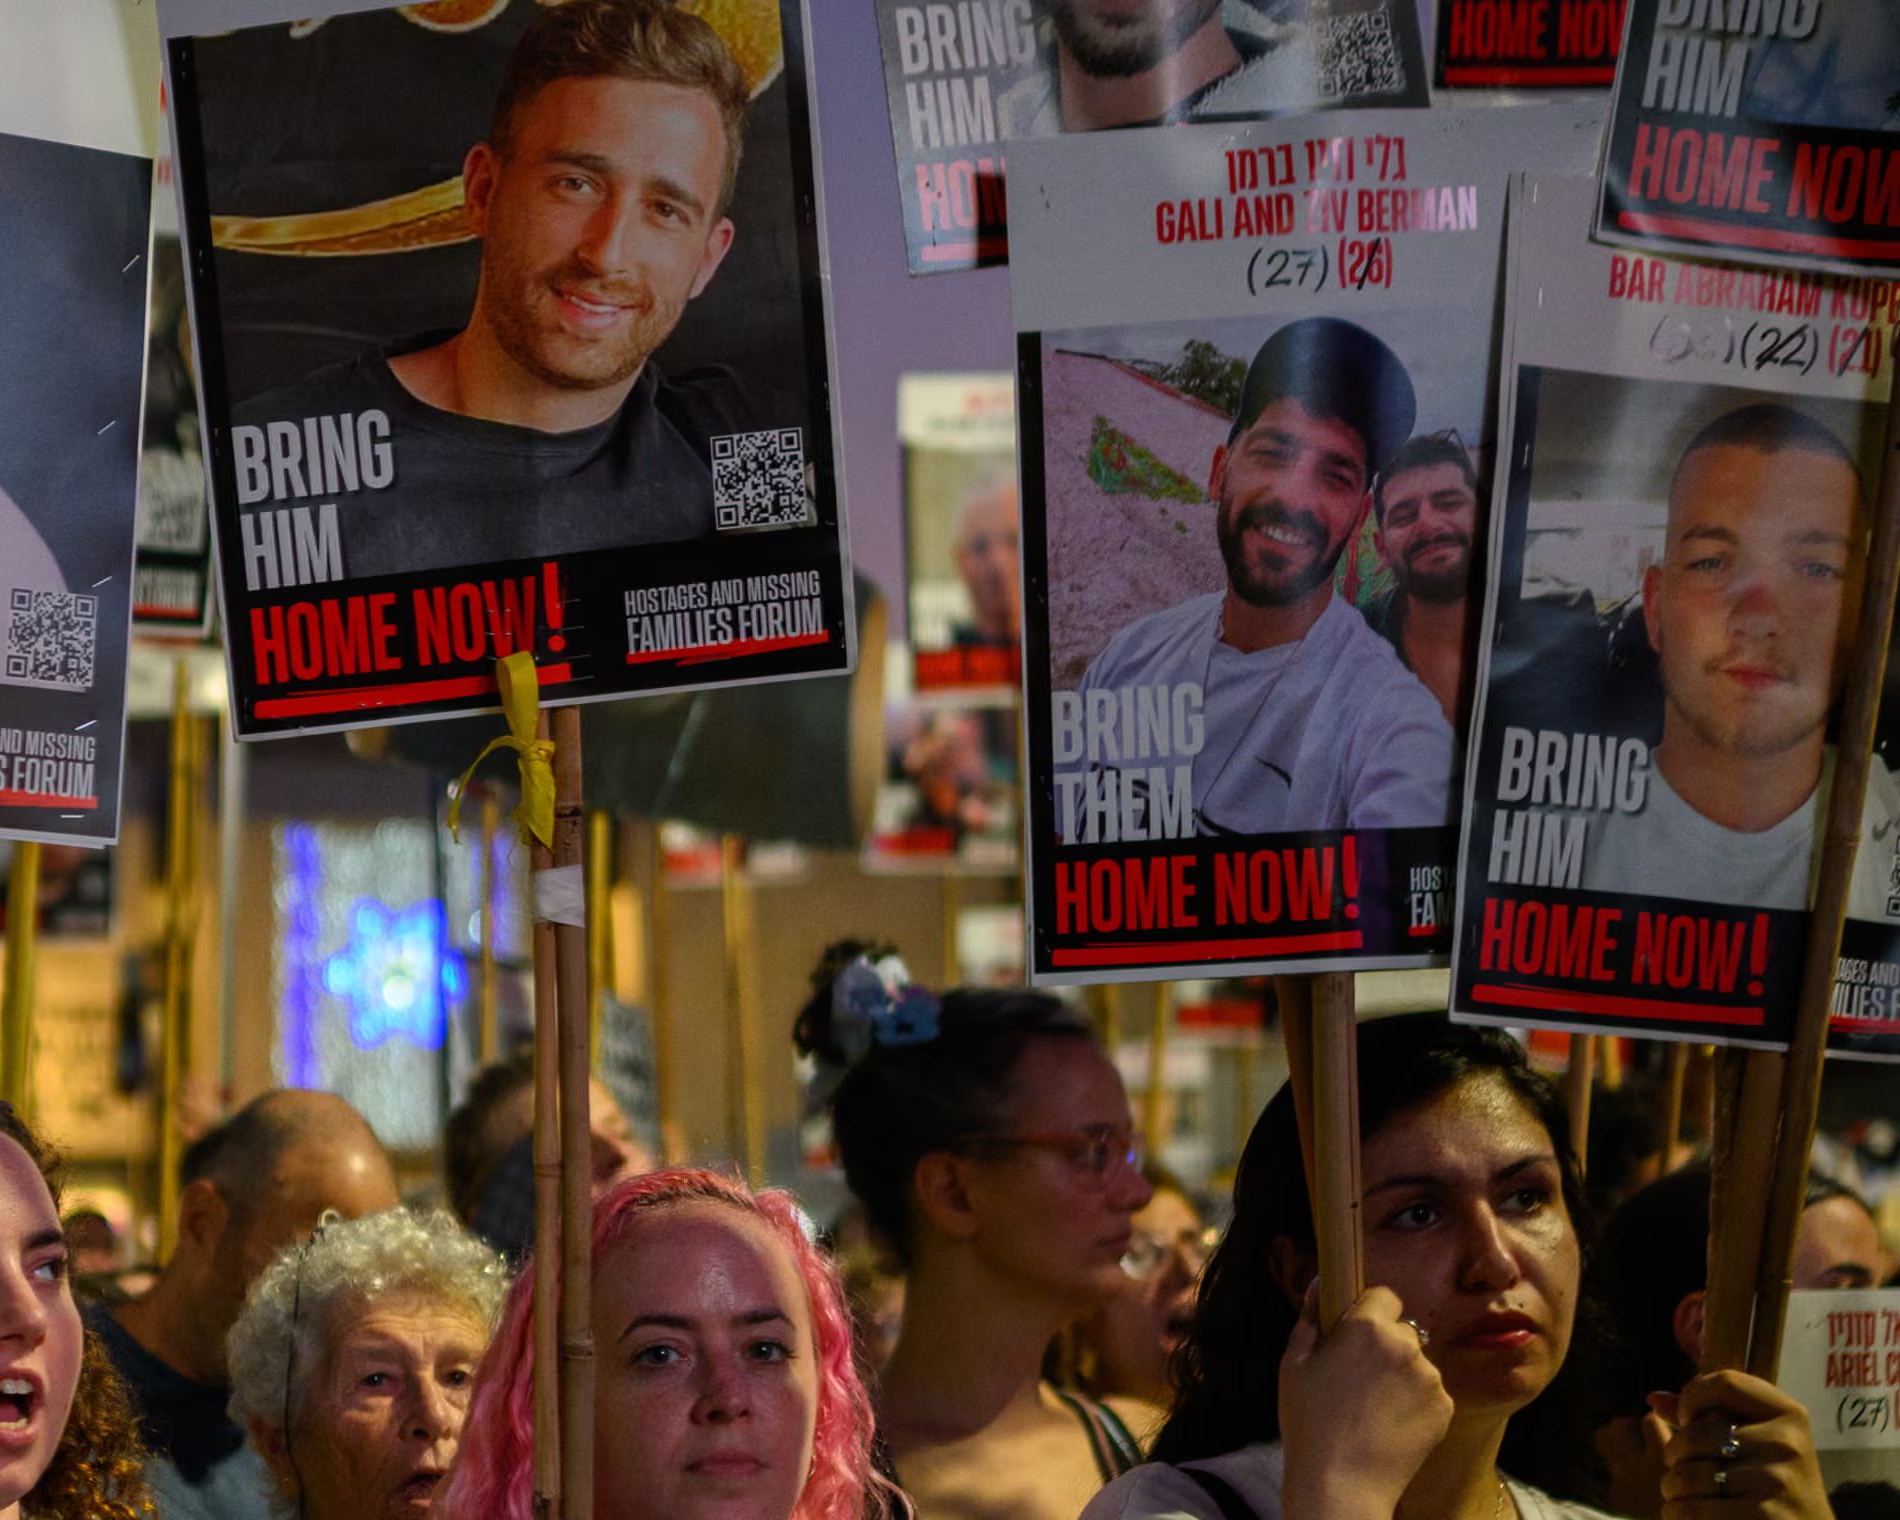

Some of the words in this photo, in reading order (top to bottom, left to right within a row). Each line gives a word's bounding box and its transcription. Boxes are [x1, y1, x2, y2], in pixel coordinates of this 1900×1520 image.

[896, 0, 1037, 75] BRING
[1448, 0, 1551, 60] HOME
[1641, 32, 1752, 118] HIM
[906, 76, 996, 149] HIM
[1225, 143, 1296, 194] ברמן
[1365, 133, 1406, 181] גלי
[1628, 123, 1780, 214] HOME
[1156, 196, 1223, 246] GALI
[1233, 193, 1296, 239] AND
[1304, 188, 1349, 235] ZIV
[1357, 185, 1477, 234] BERMAN
[1247, 244, 1329, 296] (27)
[1609, 254, 1667, 304] BAR
[231, 409, 395, 504] BRING
[240, 504, 344, 592] HIM
[249, 592, 403, 686] HOME
[412, 561, 566, 658] NOW!
[624, 581, 708, 616] HOSTAGES
[711, 578, 744, 607] AND
[746, 570, 821, 602] MISSING
[627, 607, 734, 655] FAMILIES
[738, 597, 823, 642] FORUM
[26, 731, 96, 762] MISSING
[1051, 681, 1205, 764] BRING
[12, 758, 95, 798] FORUM
[1053, 765, 1197, 846] THEM
[1497, 726, 1650, 813] BRING
[1055, 853, 1199, 935] HOME
[1214, 835, 1362, 929] NOW!
[1487, 808, 1587, 888] HIM
[1479, 897, 1623, 982] HOME
[1631, 912, 1772, 997] NOW!
[1824, 1352, 1881, 1389] ARIEL
